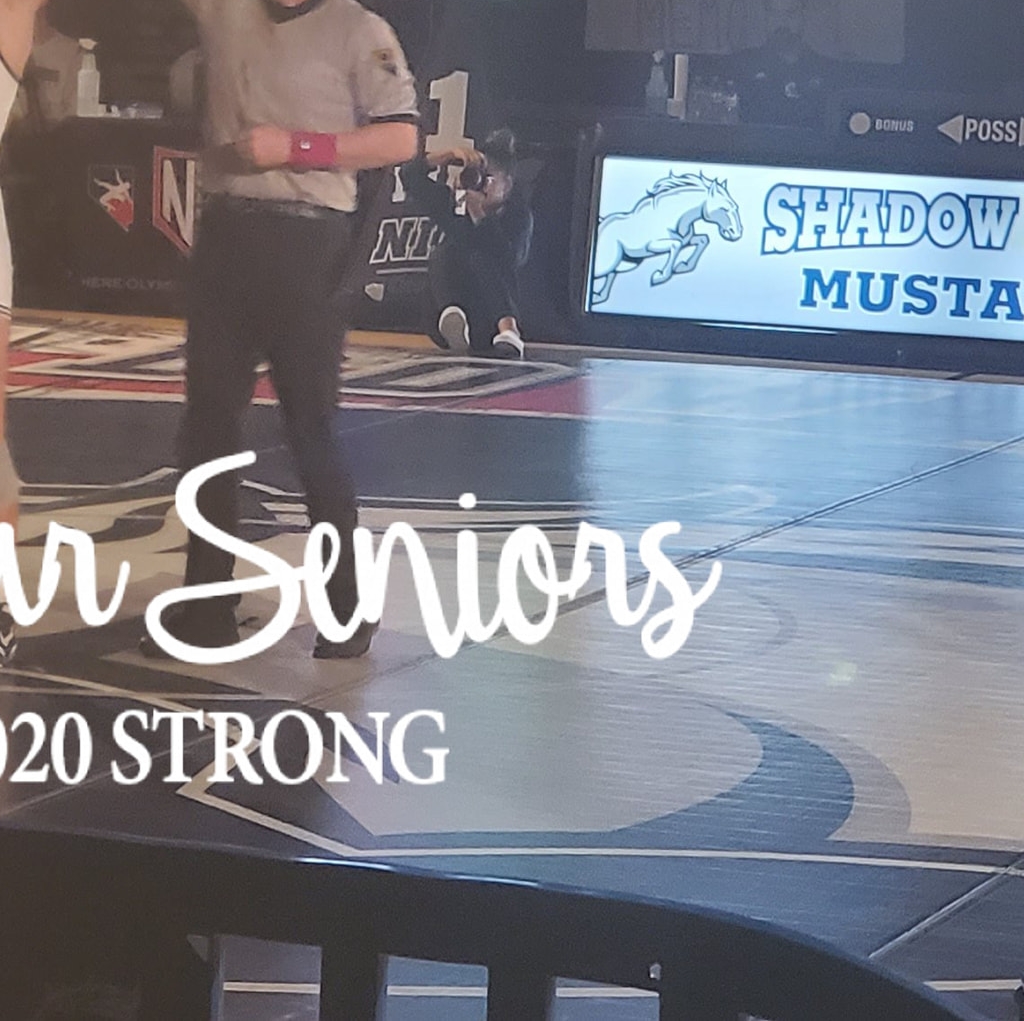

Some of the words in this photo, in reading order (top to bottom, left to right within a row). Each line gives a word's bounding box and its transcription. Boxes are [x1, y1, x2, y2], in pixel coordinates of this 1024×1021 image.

[875, 118, 915, 133] BONUS
[964, 117, 1018, 143] POSS
[759, 182, 1020, 256] SHADOW
